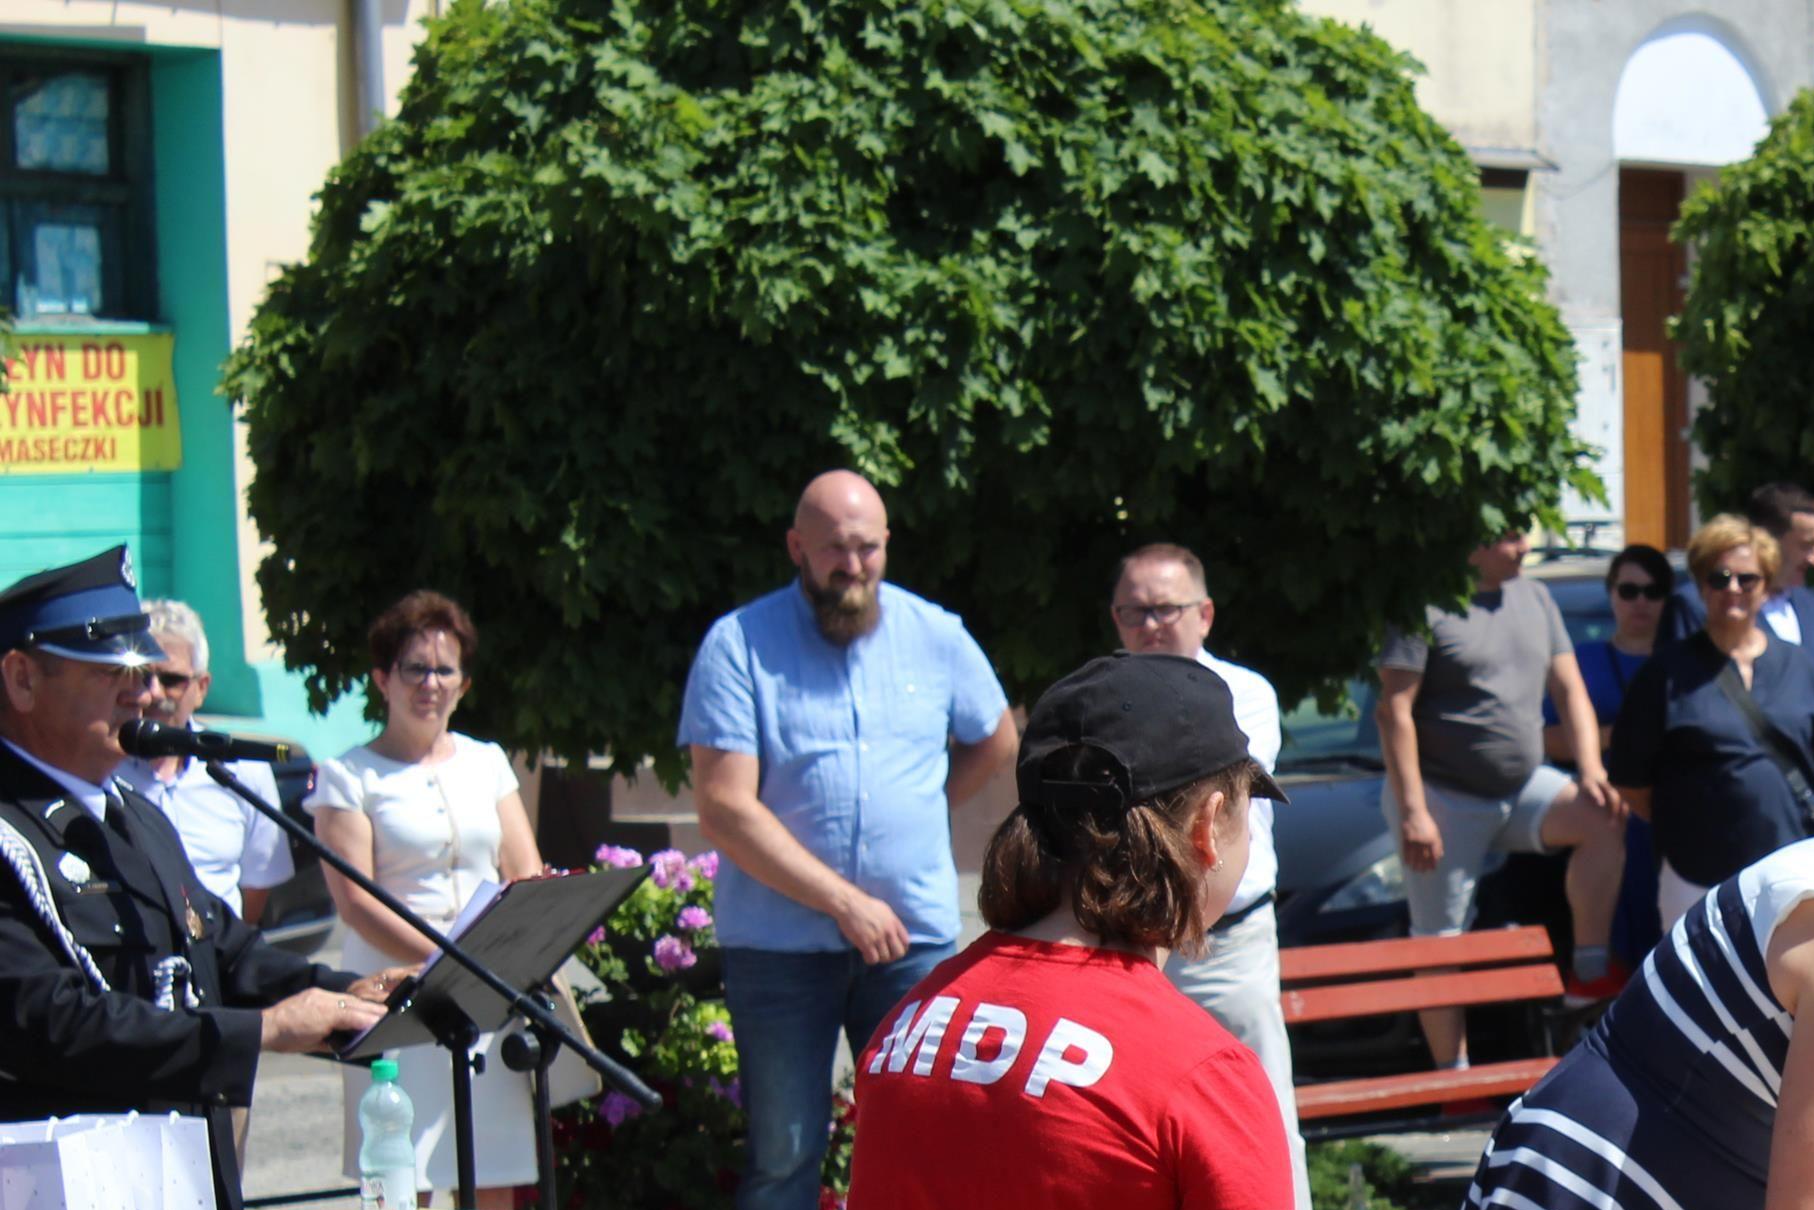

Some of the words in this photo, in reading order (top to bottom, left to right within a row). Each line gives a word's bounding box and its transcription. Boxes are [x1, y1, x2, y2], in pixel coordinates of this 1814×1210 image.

[82, 340, 127, 381] DO
[0, 385, 165, 429] YNFEKCJI
[868, 995, 1114, 1098] MDP
